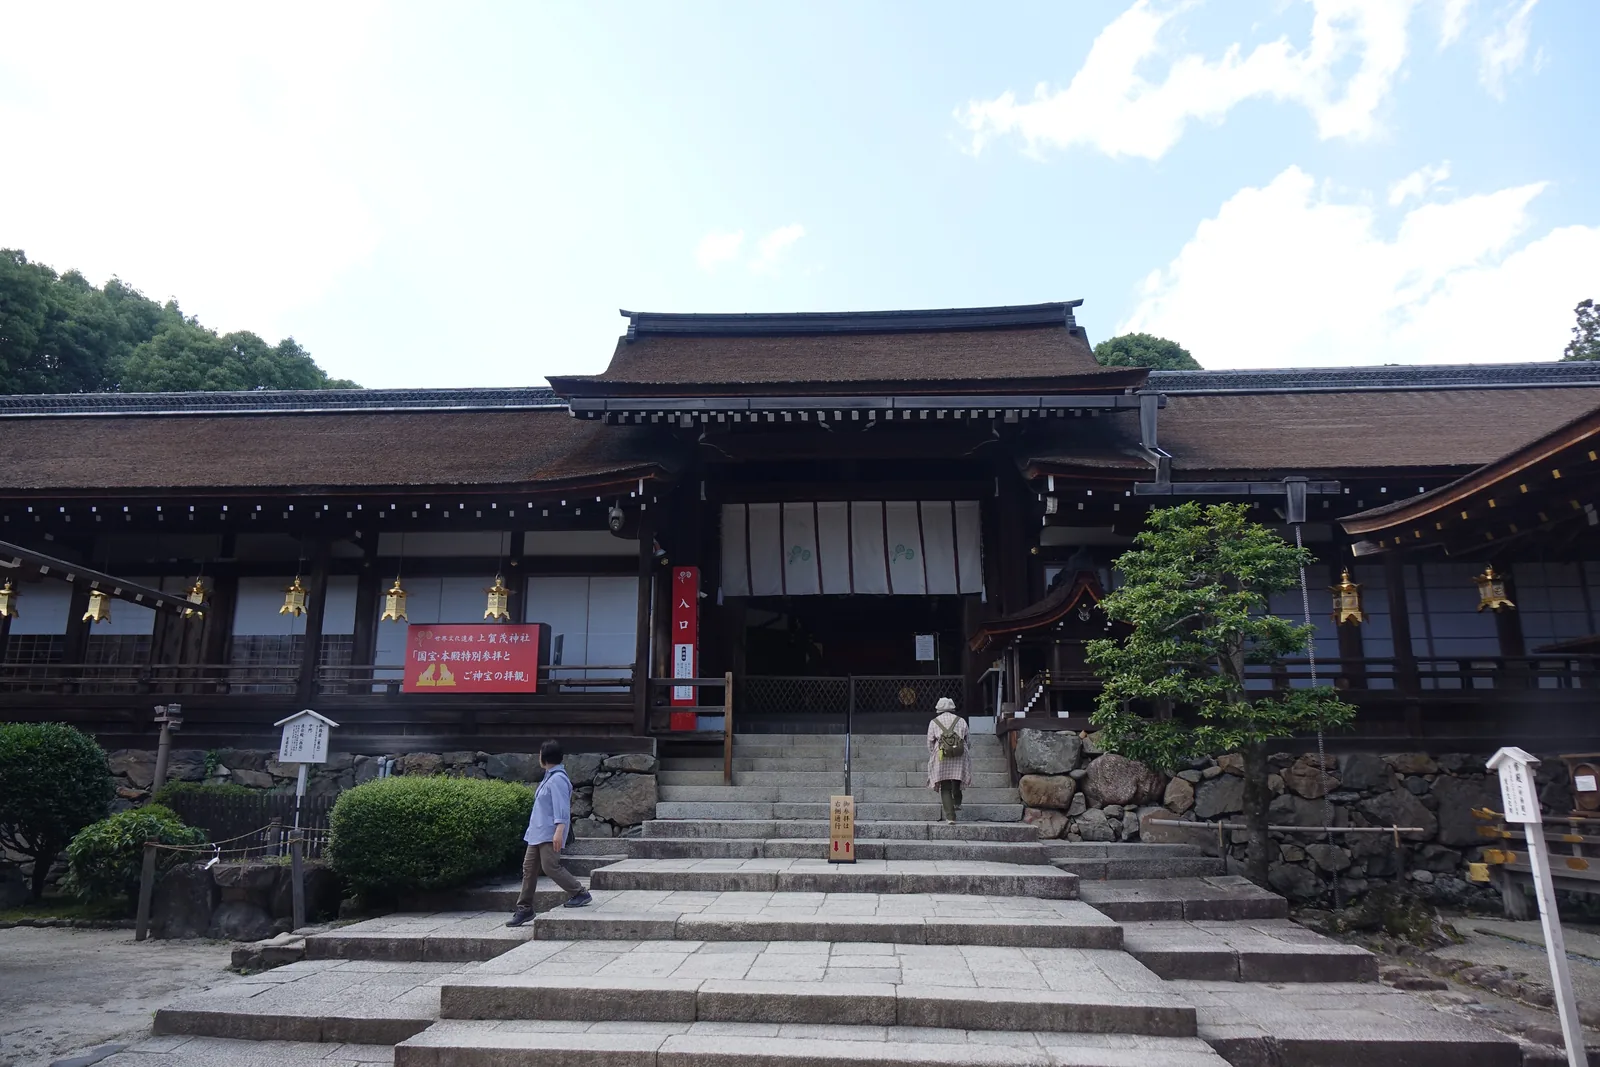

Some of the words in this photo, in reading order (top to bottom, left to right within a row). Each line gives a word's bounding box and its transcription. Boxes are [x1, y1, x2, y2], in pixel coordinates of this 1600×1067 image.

[678, 598, 691, 630] 入口
[477, 633, 531, 644] 上賀茂神社
[843, 800, 851, 829] 御参拝は
